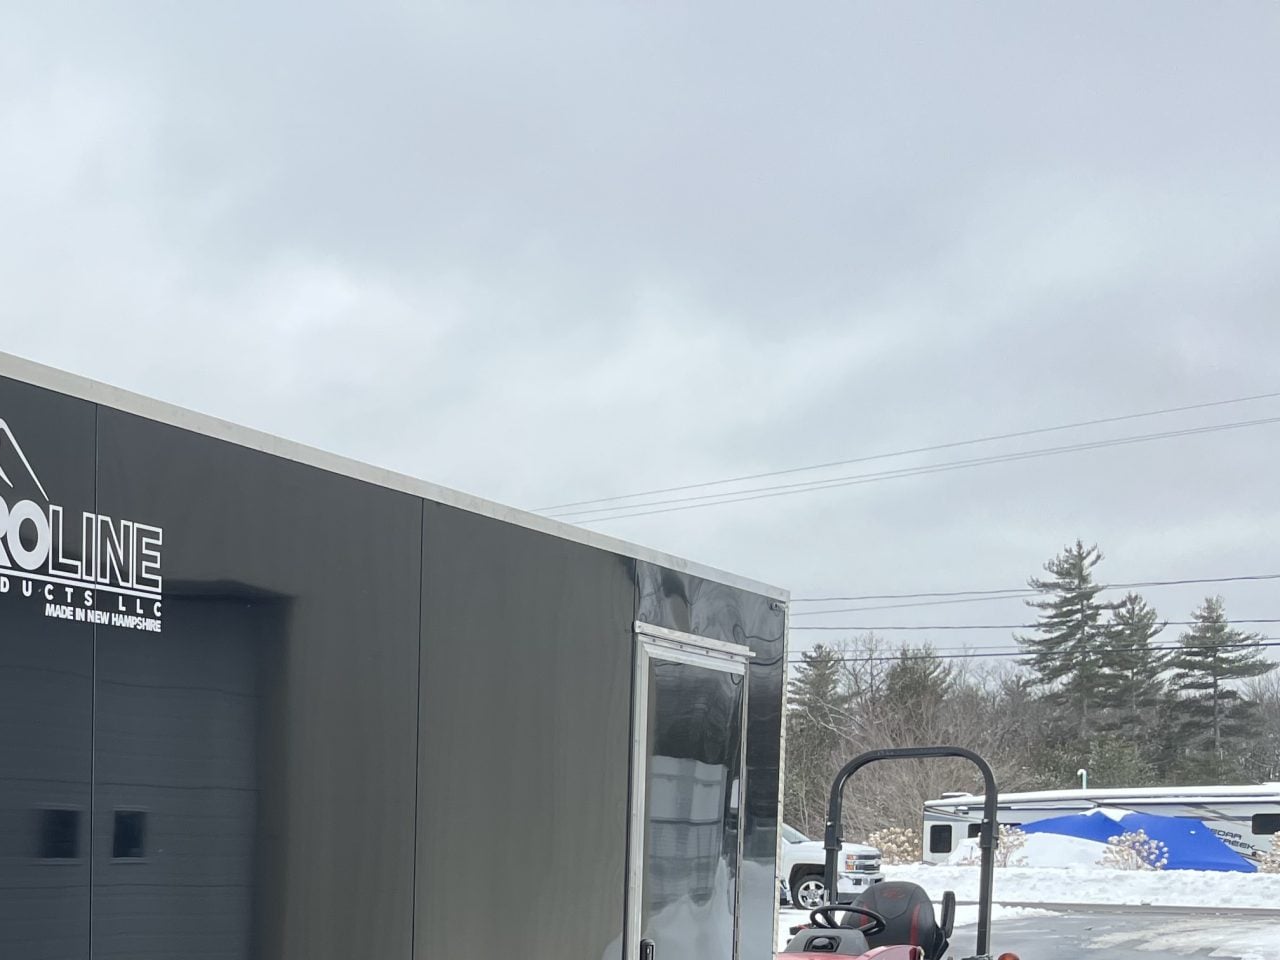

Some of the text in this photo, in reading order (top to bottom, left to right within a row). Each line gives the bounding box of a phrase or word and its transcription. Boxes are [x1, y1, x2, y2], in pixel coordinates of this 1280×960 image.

[118, 595, 162, 617] LLC
[44, 602, 162, 633] MADE IN NEW HAMPSHIRE
[1207, 827, 1243, 841] EDAR
[1218, 837, 1255, 850] REEK
